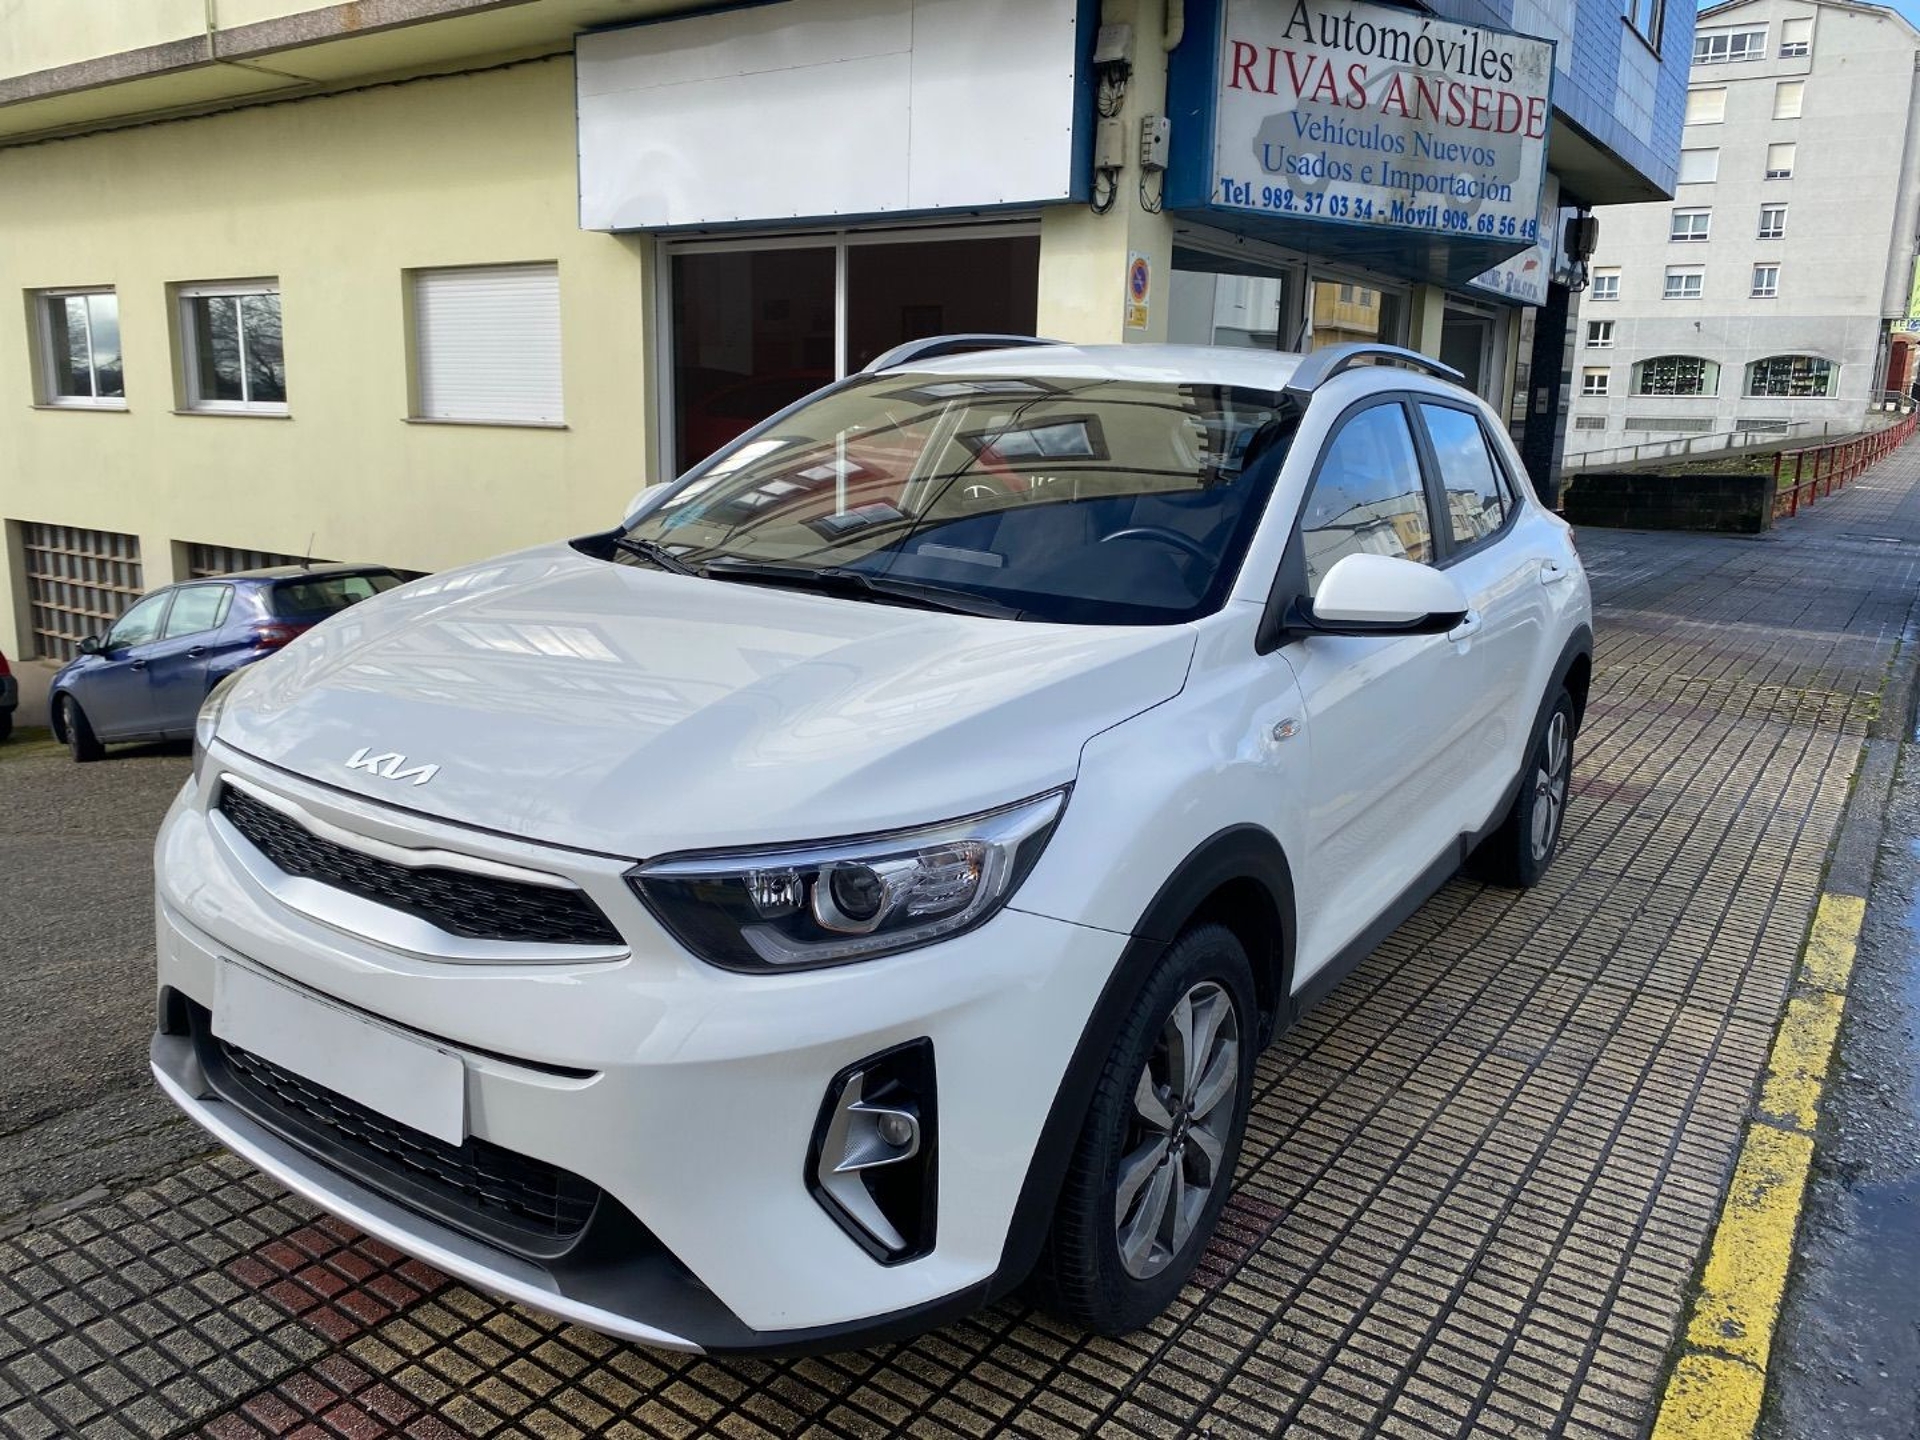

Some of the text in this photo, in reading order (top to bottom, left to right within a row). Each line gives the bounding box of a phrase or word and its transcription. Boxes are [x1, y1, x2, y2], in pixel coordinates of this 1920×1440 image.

[1282, 0, 1513, 84] Automóviles
[1227, 40, 1546, 140] RIVAS ANSEDE
[1291, 110, 1496, 167] Vehículos Nuevos
[1263, 143, 1513, 202] Usados e Importación
[1221, 177, 1256, 206] Tel.
[1262, 186, 1298, 212] 982.
[1304, 191, 1324, 214] 37
[1329, 195, 1348, 217] 03
[1354, 197, 1373, 220] 34
[1389, 199, 1438, 228] Móvil
[1442, 209, 1472, 232] 908.
[1477, 212, 1495, 234] 68
[1498, 215, 1516, 236] 56
[1520, 218, 1537, 239] 48
[344, 747, 441, 787] KIA
